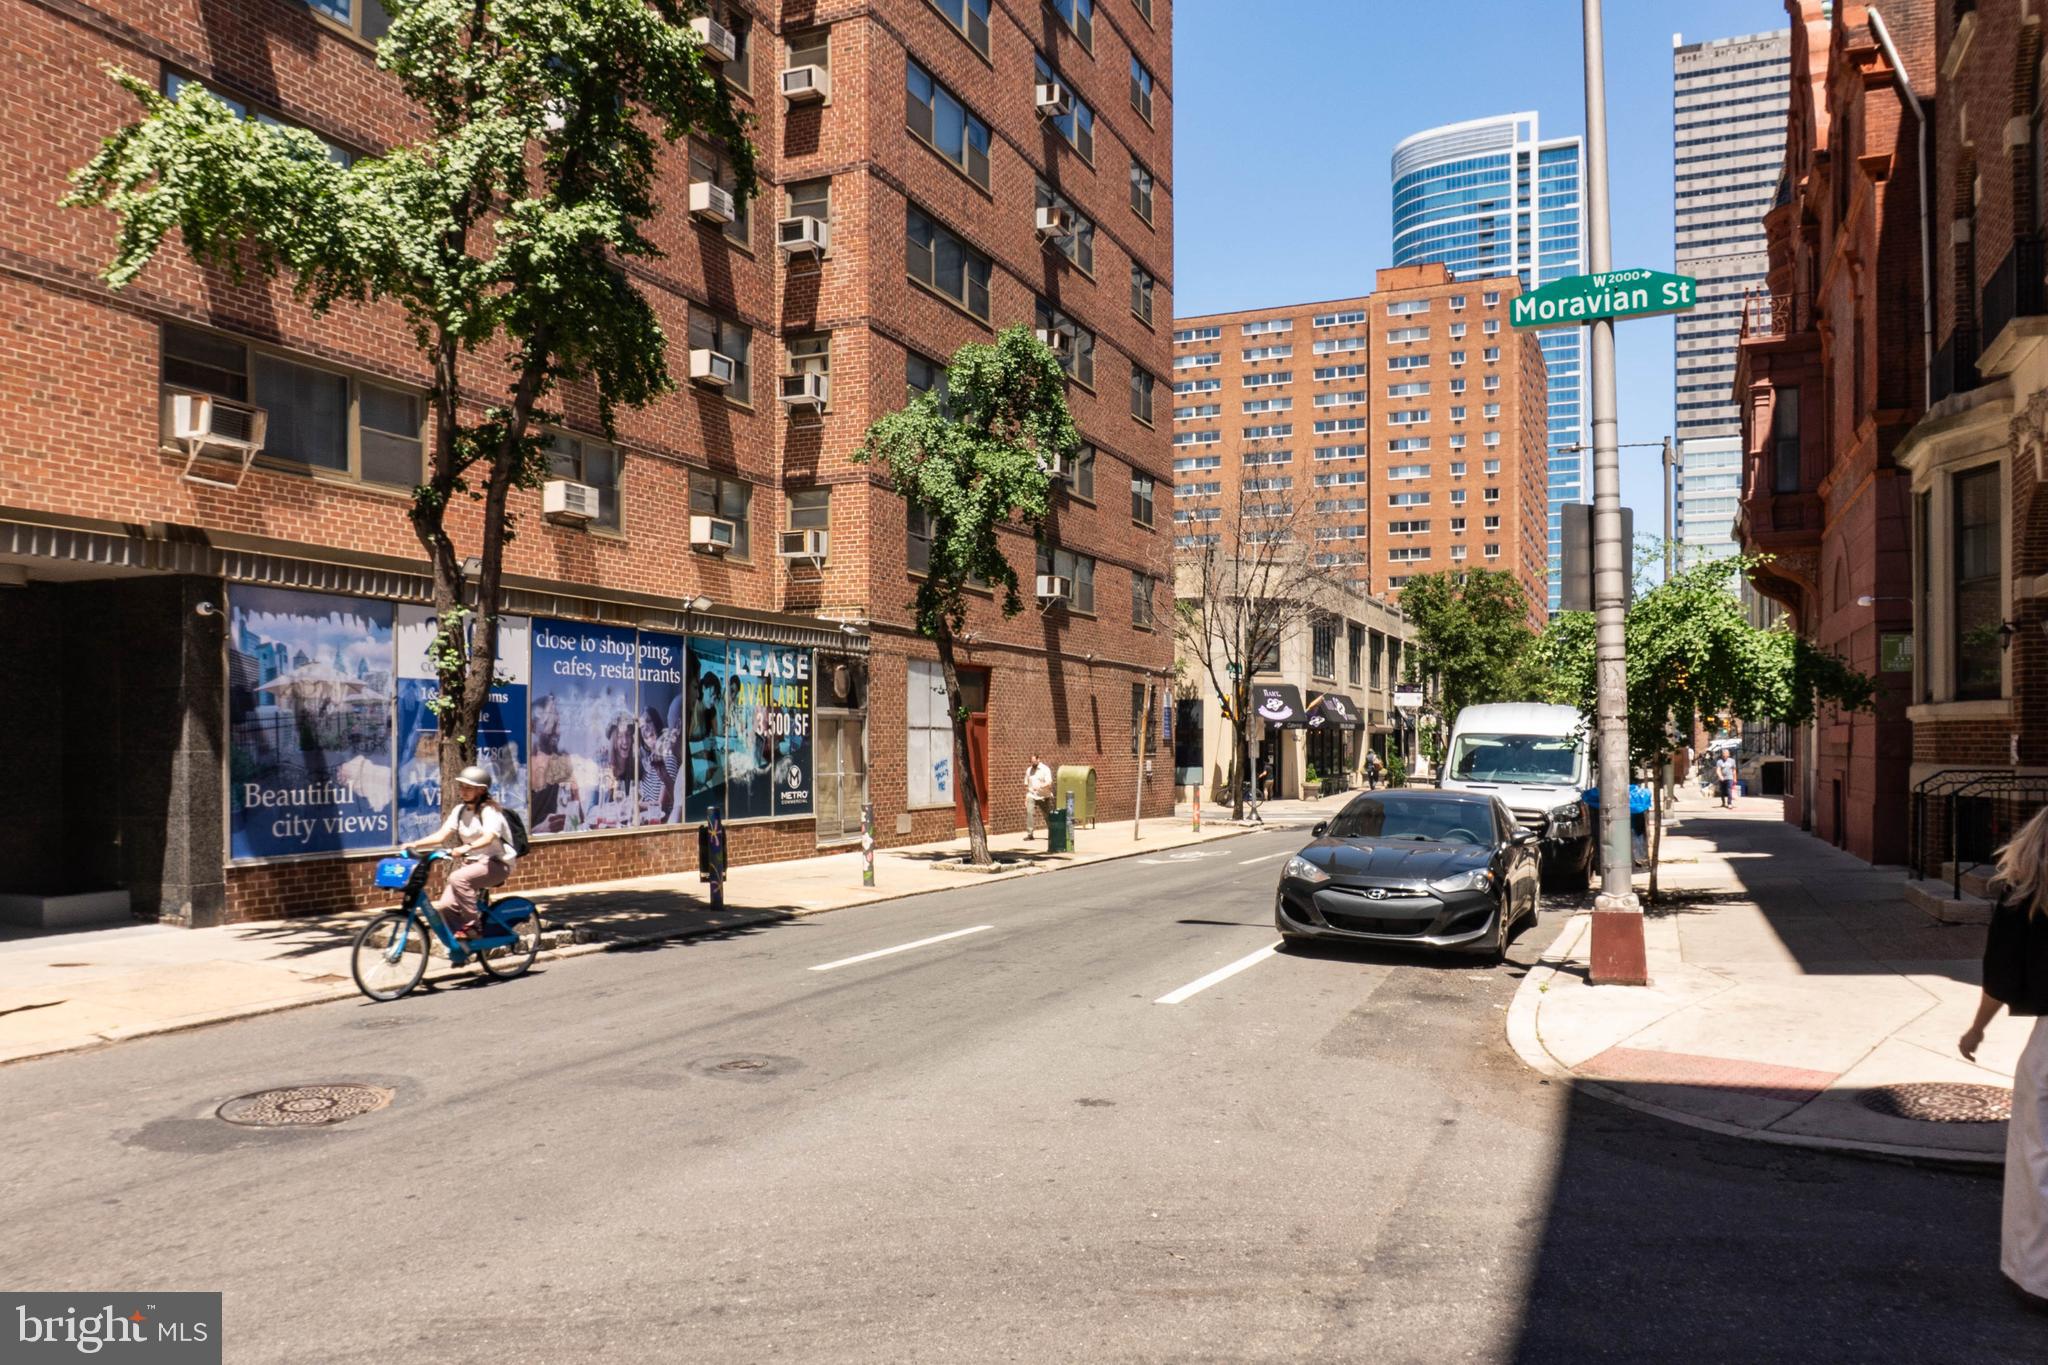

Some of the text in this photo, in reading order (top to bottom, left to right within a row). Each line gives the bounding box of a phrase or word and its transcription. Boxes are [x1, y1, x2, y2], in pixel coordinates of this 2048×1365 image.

[1593, 271, 1640, 288] W 2000
[1515, 281, 1690, 322] Moravian St
[536, 627, 673, 666] close to shopping,
[553, 655, 680, 684] cafes, restaurants
[735, 648, 808, 680] LEASE
[738, 682, 809, 708] AVAILABLE
[794, 713, 809, 736] SF
[243, 780, 355, 808] Beautiful
[781, 791, 808, 800] METRO
[272, 811, 388, 844] city views
